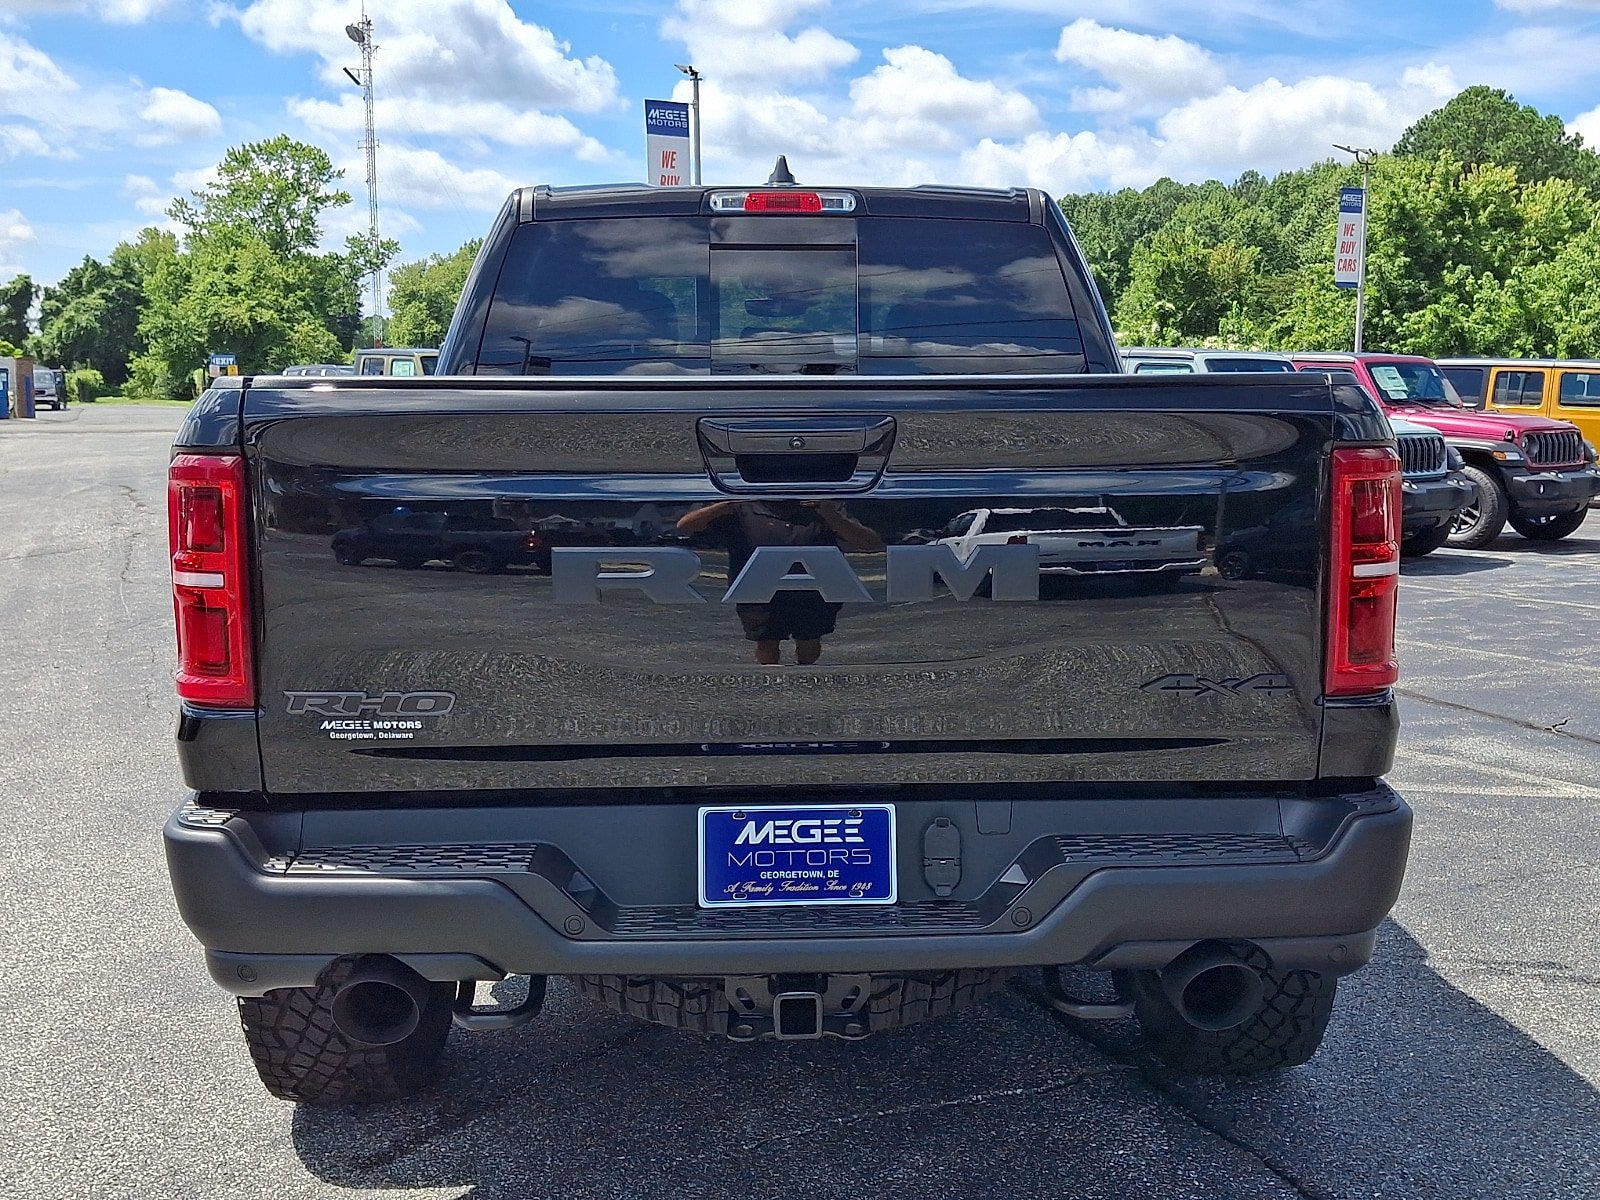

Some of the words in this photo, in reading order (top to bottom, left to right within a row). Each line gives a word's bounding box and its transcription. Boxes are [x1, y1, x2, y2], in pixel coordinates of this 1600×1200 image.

[648, 109, 687, 121] MEGEE
[648, 119, 688, 128] MOTORS
[662, 150, 677, 169] WE
[1343, 223, 1355, 237] WE
[1340, 241, 1356, 254] BUY
[1337, 259, 1357, 272] CARS
[550, 545, 1041, 605] RAM
[283, 690, 457, 717] RHO
[319, 720, 372, 730] MEGEE
[373, 720, 423, 730] MOTORS
[329, 731, 377, 741] Georgetown,
[378, 731, 414, 740] Delaware
[734, 818, 865, 845] MEGEE
[727, 848, 872, 867] MOTORS
[760, 870, 826, 880] GEORGETOWN,
[827, 869, 840, 878] DE
[723, 881, 741, 894] A
[741, 880, 774, 895] Family
[778, 880, 820, 892] Tradition
[823, 879, 848, 891] Since
[850, 881, 873, 891] 1948
